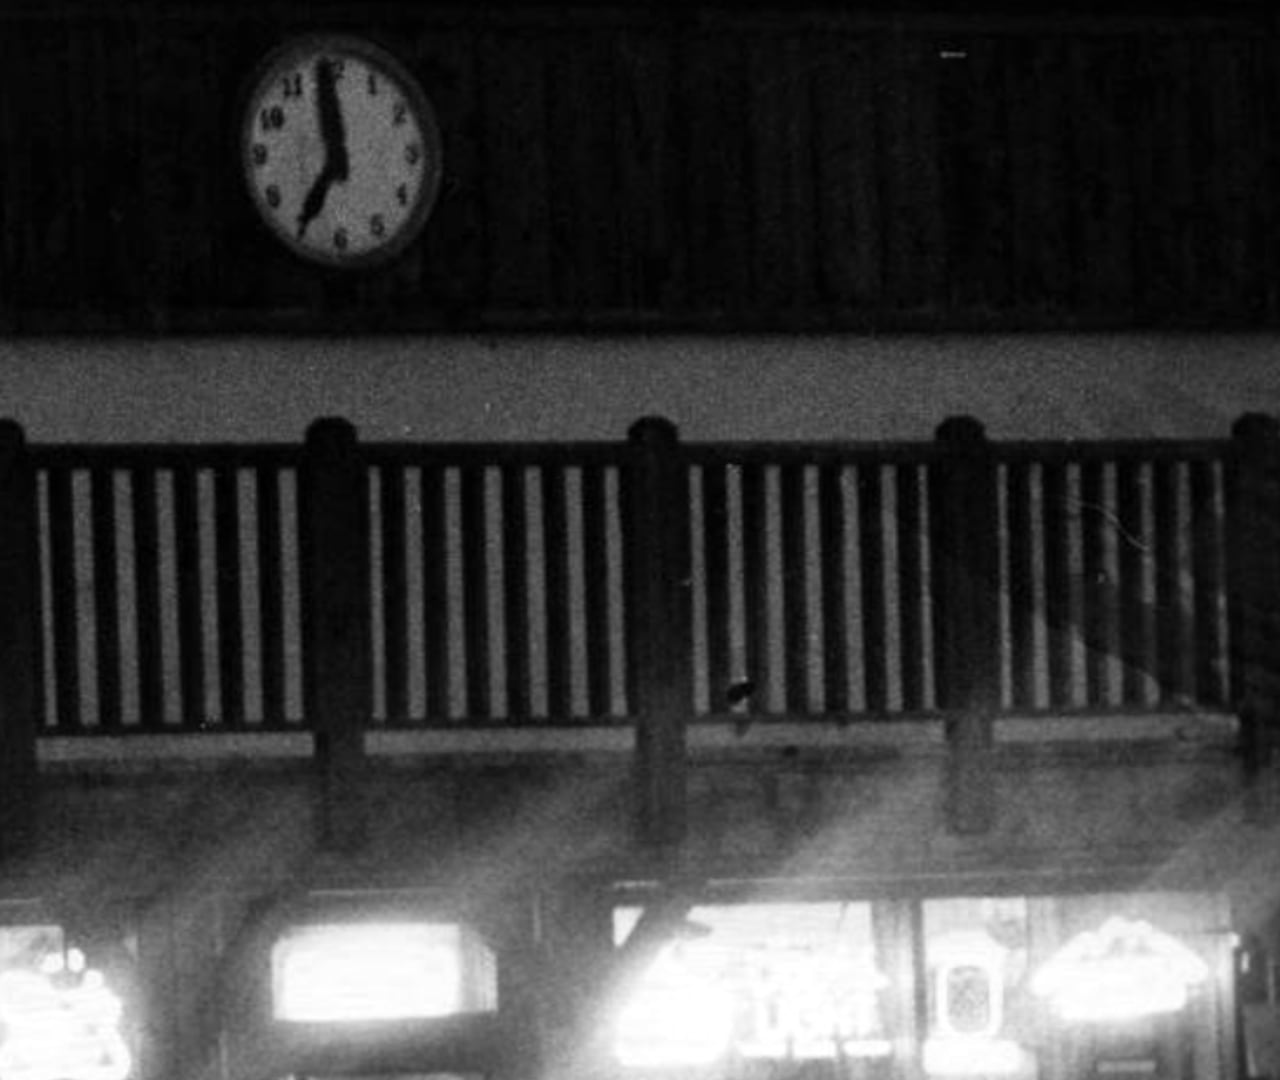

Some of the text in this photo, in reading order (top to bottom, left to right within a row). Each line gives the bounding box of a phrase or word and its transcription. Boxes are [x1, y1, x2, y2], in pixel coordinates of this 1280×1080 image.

[282, 72, 303, 98] 11
[367, 73, 377, 96] 1
[259, 105, 285, 132] 10
[391, 102, 407, 127] 2
[252, 142, 268, 166] 9
[404, 143, 419, 166] 3
[265, 184, 281, 209] 8
[395, 181, 408, 206] 4
[369, 212, 385, 237] 5
[332, 226, 348, 250] 6
